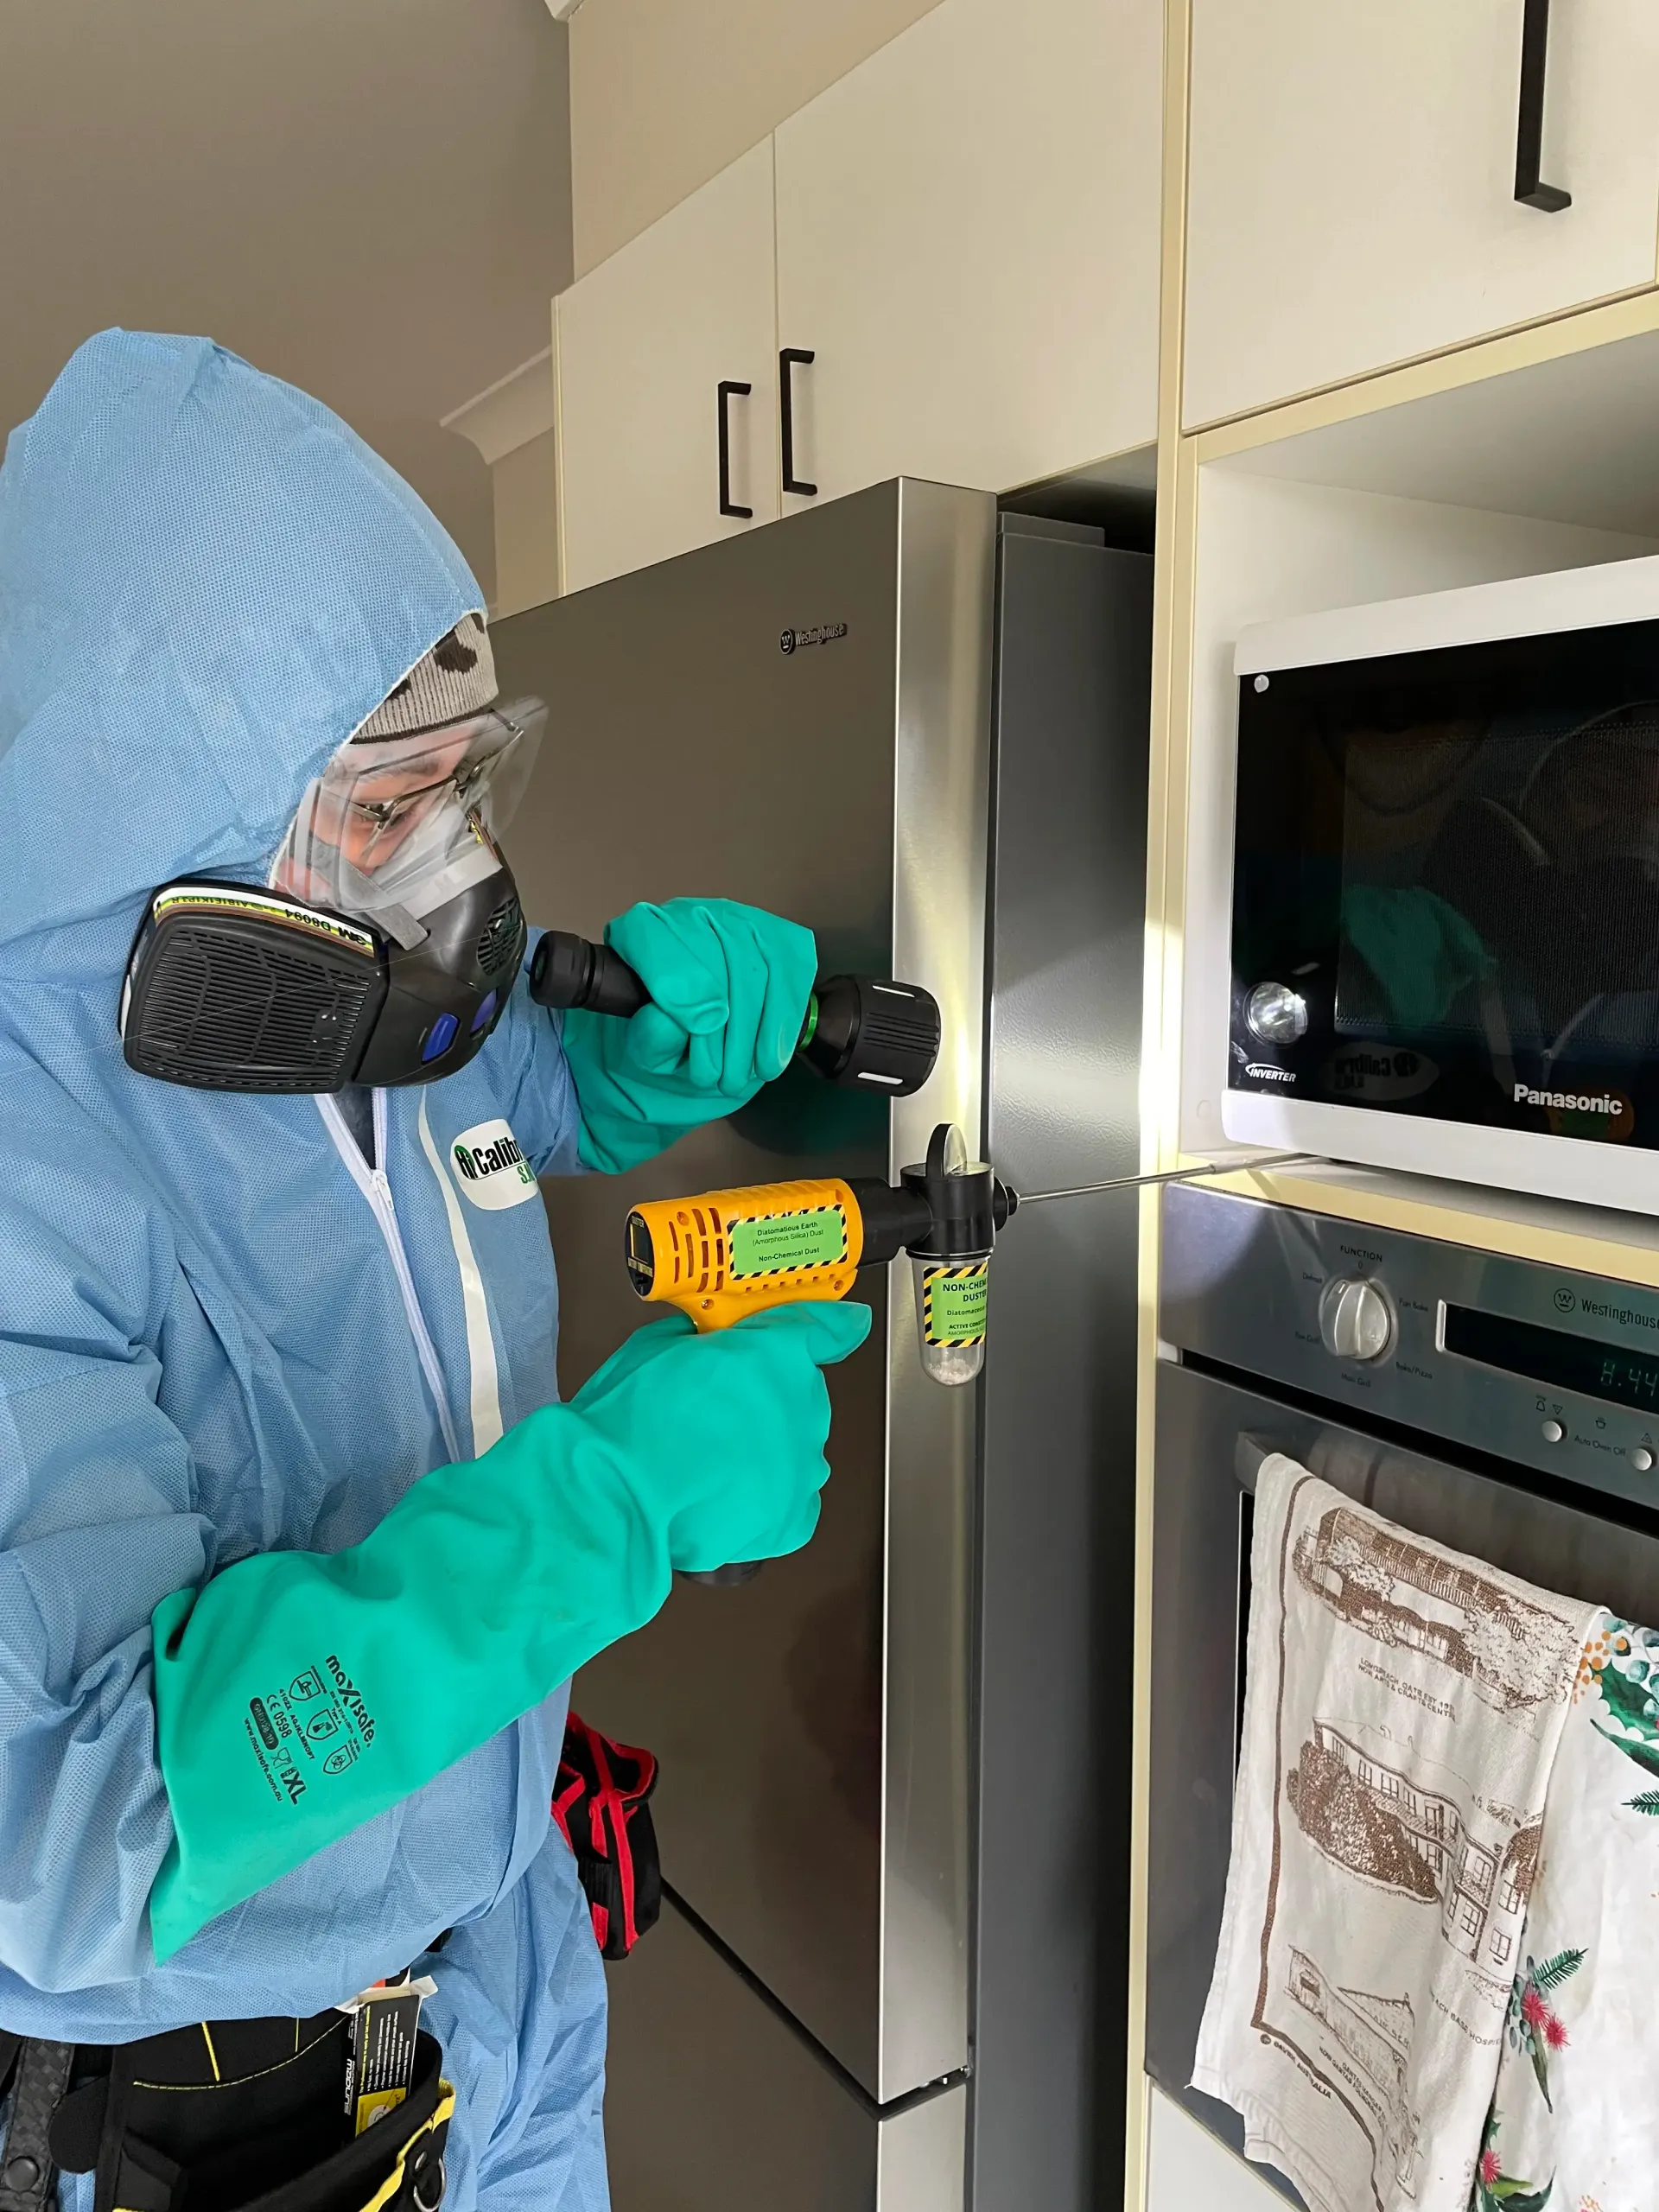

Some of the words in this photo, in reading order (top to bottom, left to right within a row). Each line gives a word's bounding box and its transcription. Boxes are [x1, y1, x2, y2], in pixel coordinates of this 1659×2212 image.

[795, 623, 845, 646] Westinghouse
[284, 908, 331, 931] D8094
[339, 926, 367, 946] 3M
[1249, 1067, 1297, 1083] INVERTER
[1514, 1083, 1623, 1116] Panasonic
[752, 1236, 789, 1247] (Amorphous
[790, 1231, 809, 1240] Silica)
[757, 1224, 799, 1236] Diatomatious
[758, 1249, 804, 1262] Non-Chemical
[804, 1247, 820, 1255] Dust
[1340, 1245, 1382, 1262] FUNCTION
[1573, 1434, 1592, 1447] Auto
[1592, 1440, 1612, 1453] Oven
[1612, 1445, 1627, 1457] Off
[272, 1710, 293, 1739] 0598
[283, 1770, 308, 1806] XL
